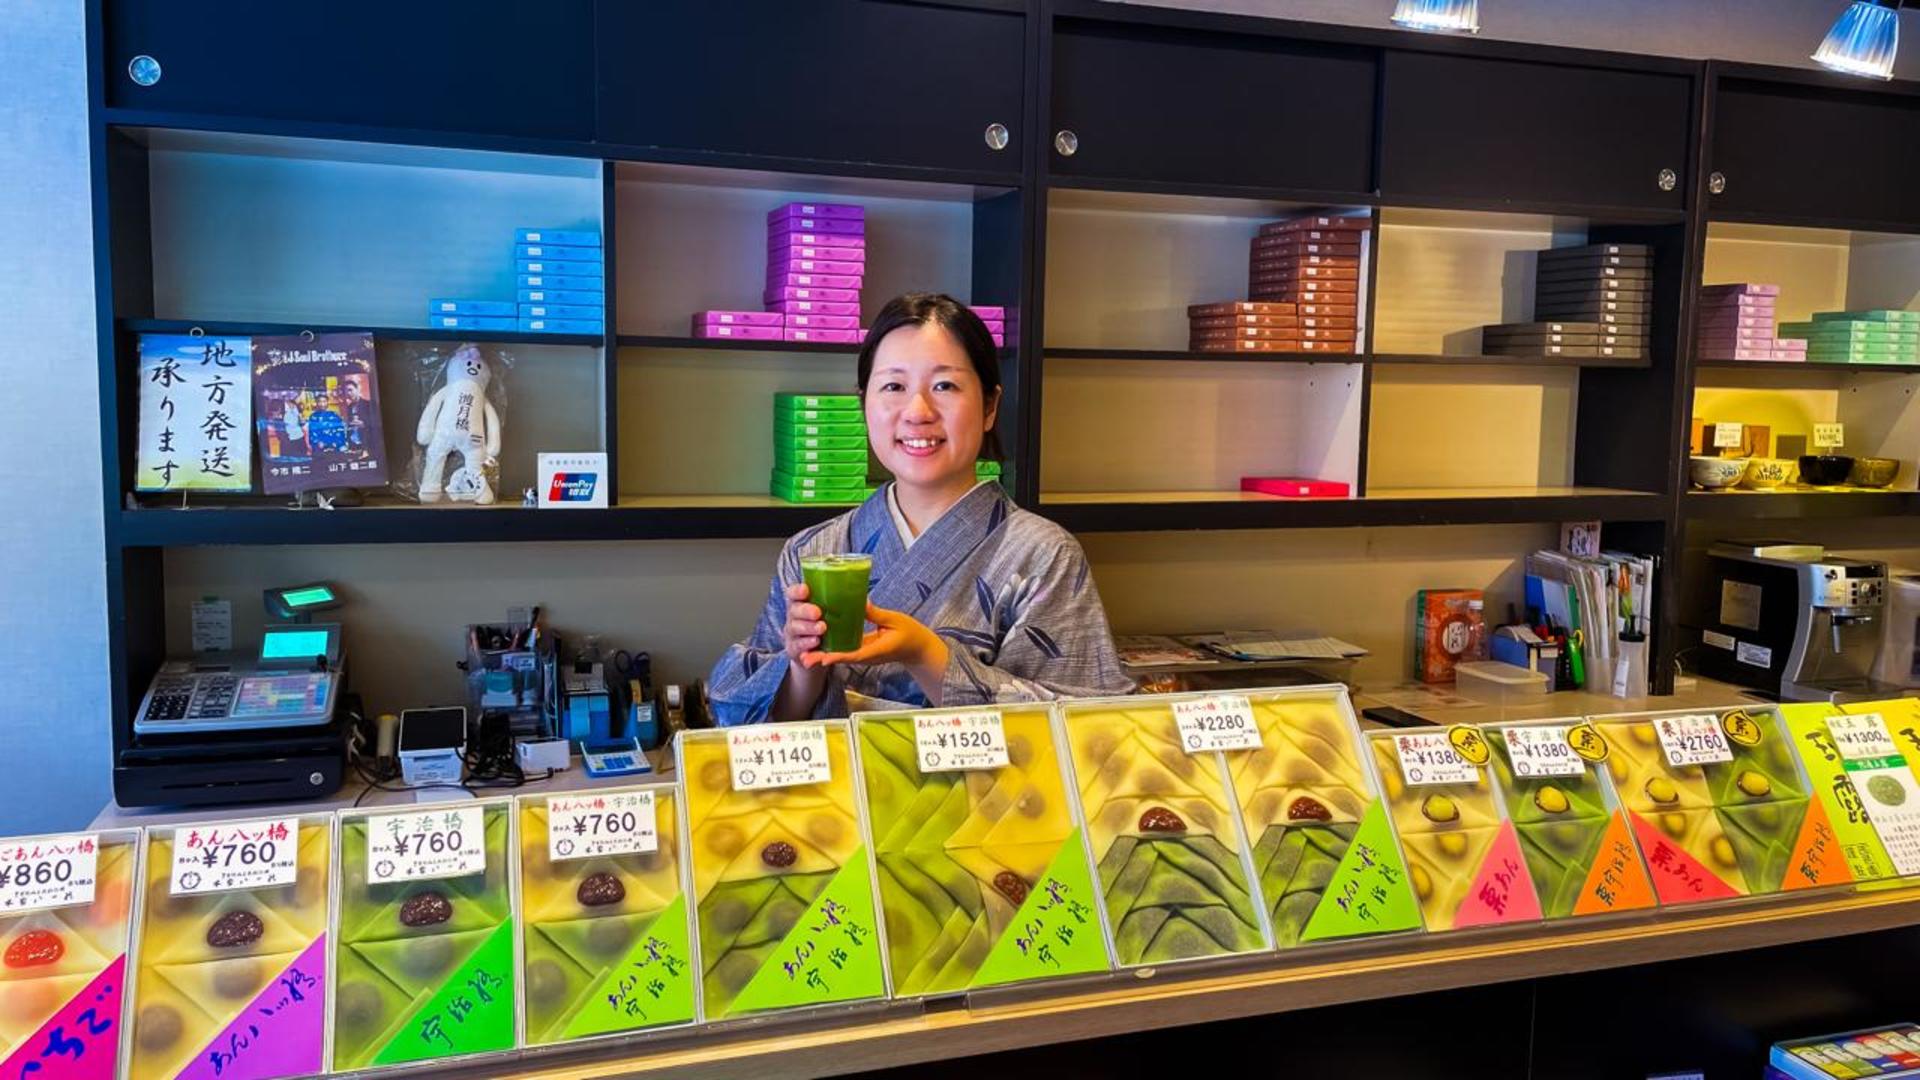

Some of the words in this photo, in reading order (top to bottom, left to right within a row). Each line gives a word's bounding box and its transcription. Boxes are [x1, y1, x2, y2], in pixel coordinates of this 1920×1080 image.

[200, 340, 236, 478] 地方発送
[151, 357, 186, 490] 承ります
[553, 480, 593, 491] UnionPay
[1195, 714, 1244, 731] ¥2280
[937, 731, 991, 748] ¥1520
[1676, 734, 1723, 751] ¥2760
[1845, 731, 1882, 744] ¥1300
[753, 746, 812, 765] ¥1140
[1416, 750, 1463, 765] ¥1380
[1523, 743, 1568, 758] ¥1380
[387, 811, 463, 836] 宇治橋
[573, 812, 636, 836] ¥760
[395, 830, 462, 857] ¥760
[202, 841, 275, 868] ¥760
[0, 859, 72, 888] ¥860
